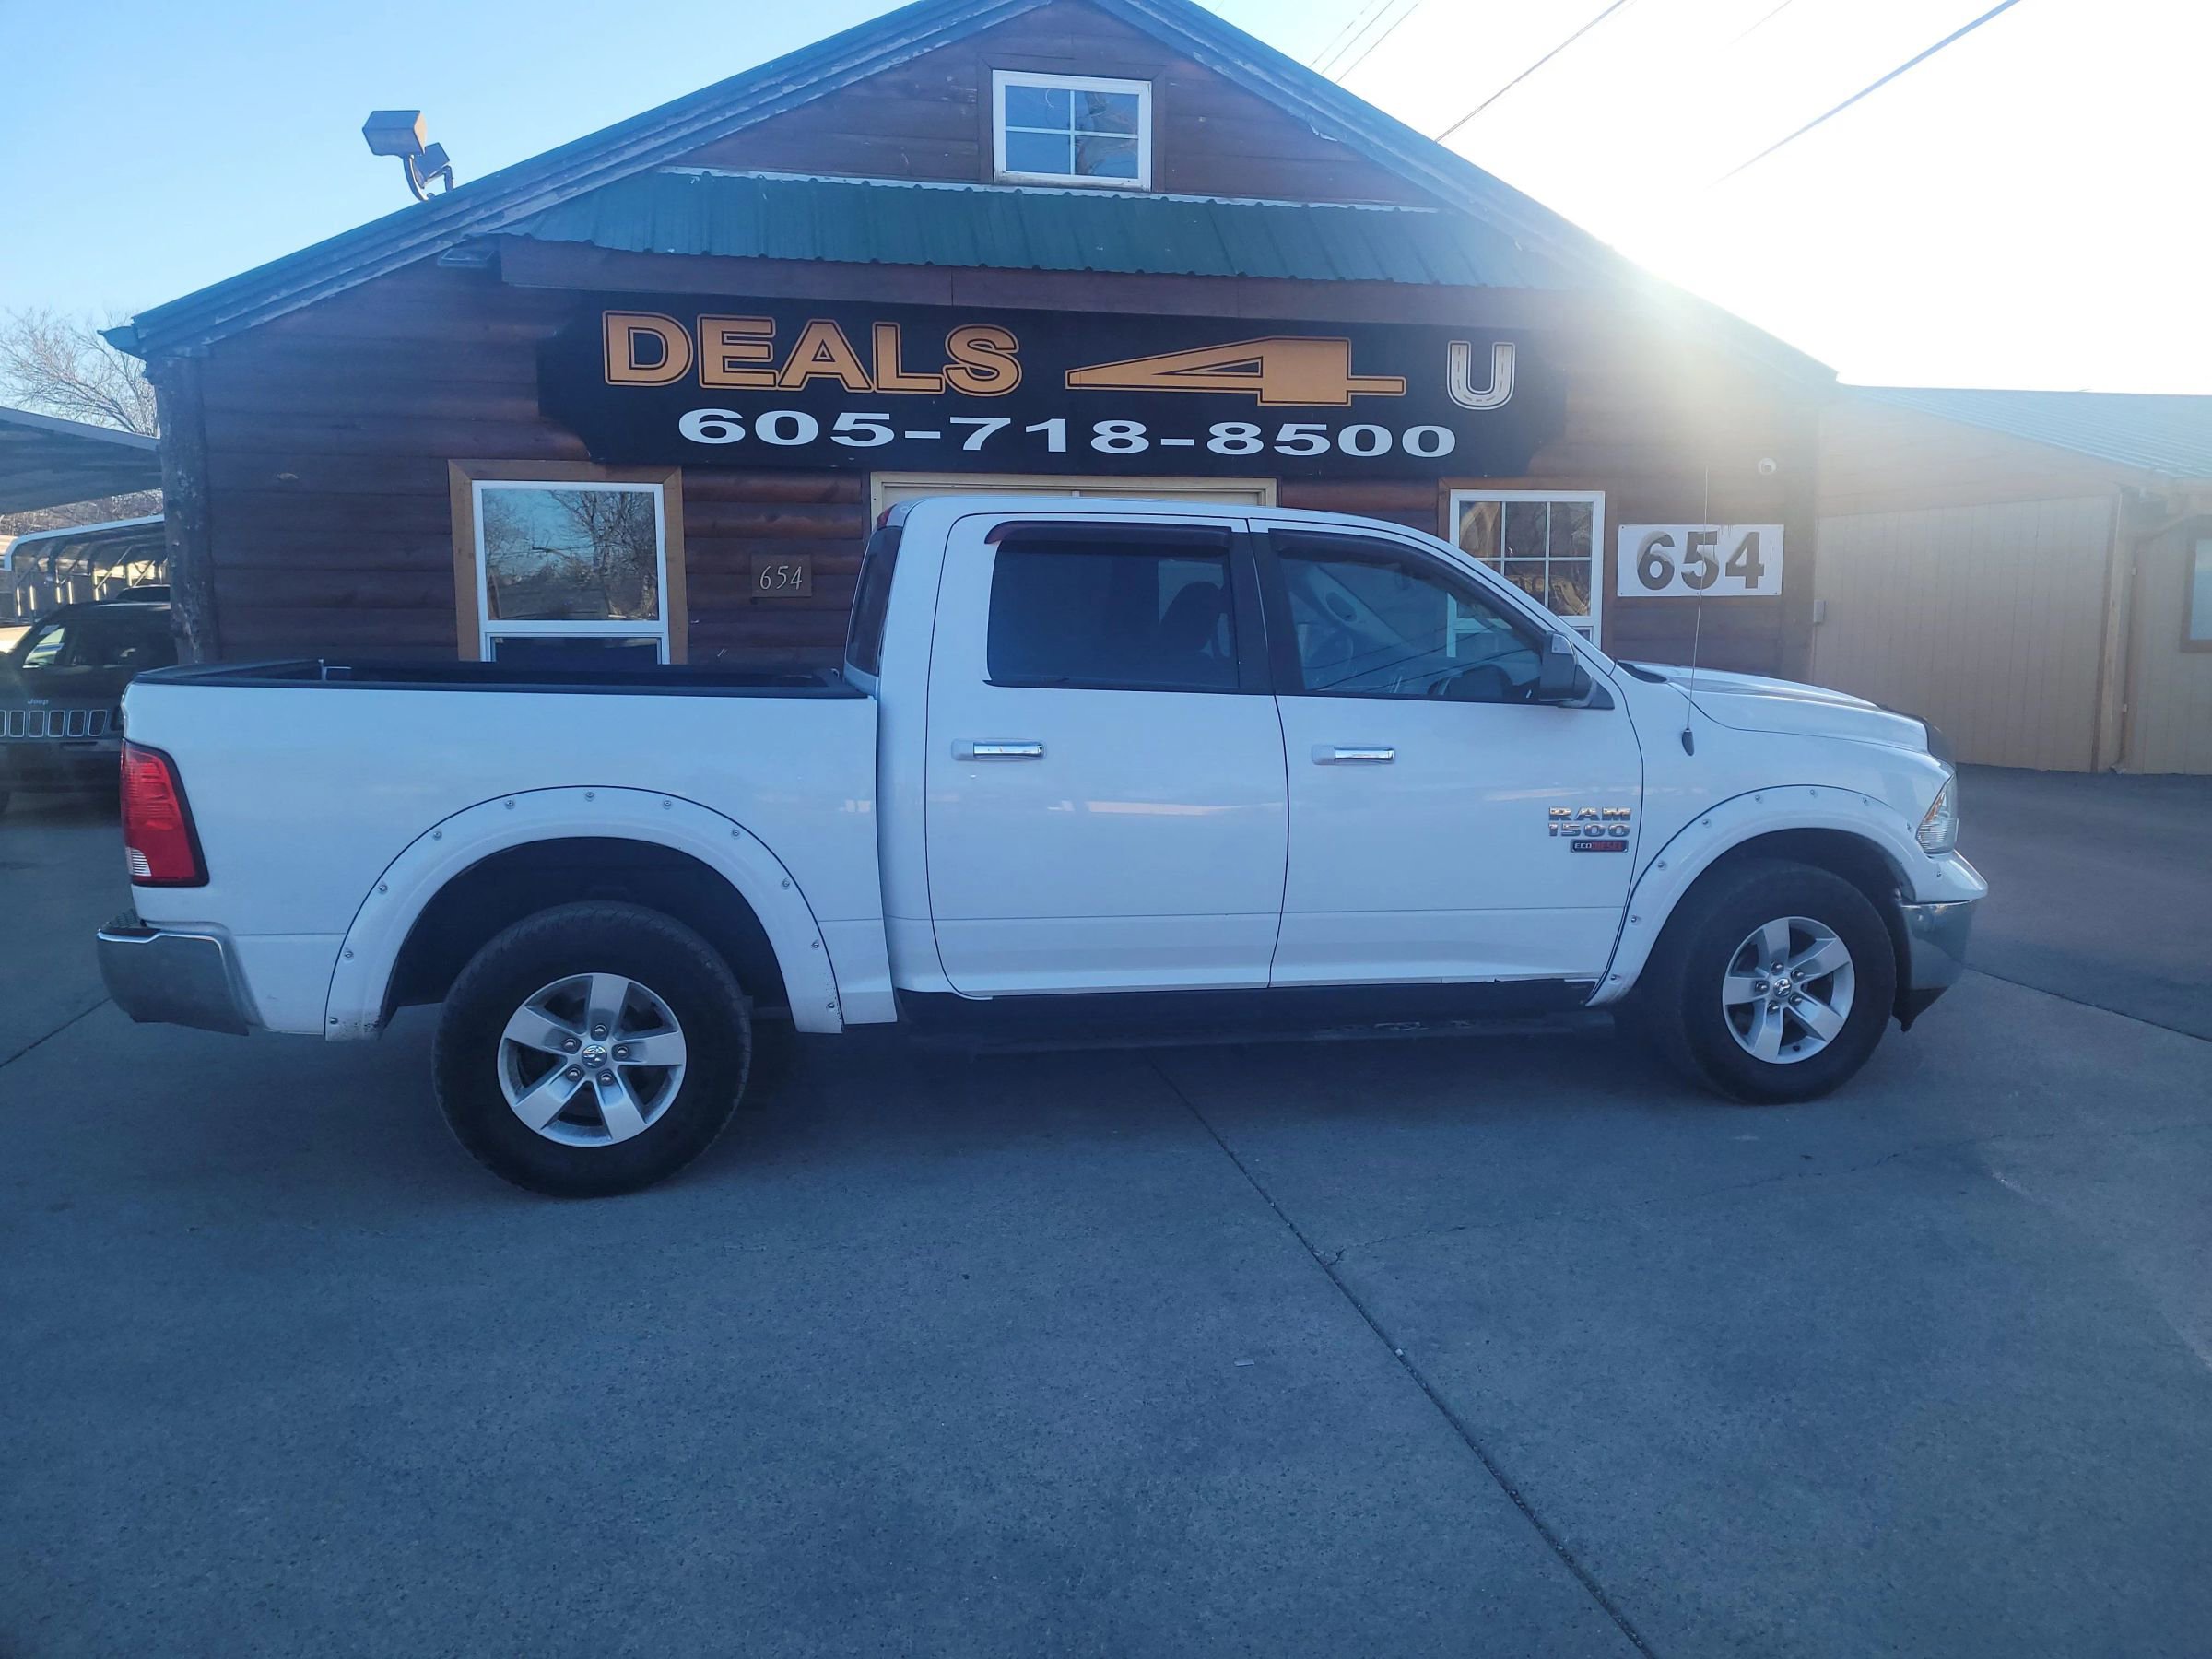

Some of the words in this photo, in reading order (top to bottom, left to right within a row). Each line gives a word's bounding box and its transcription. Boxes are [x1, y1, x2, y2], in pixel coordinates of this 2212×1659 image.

[602, 310, 1022, 397] DEALS
[1065, 335, 1406, 406] 4
[1446, 339, 1516, 410] U
[678, 408, 1457, 458] 605-718-8500
[759, 564, 803, 590] 654
[1636, 530, 1765, 591] 654
[1548, 806, 1631, 821] RAM
[1548, 823, 1630, 838] 1500
